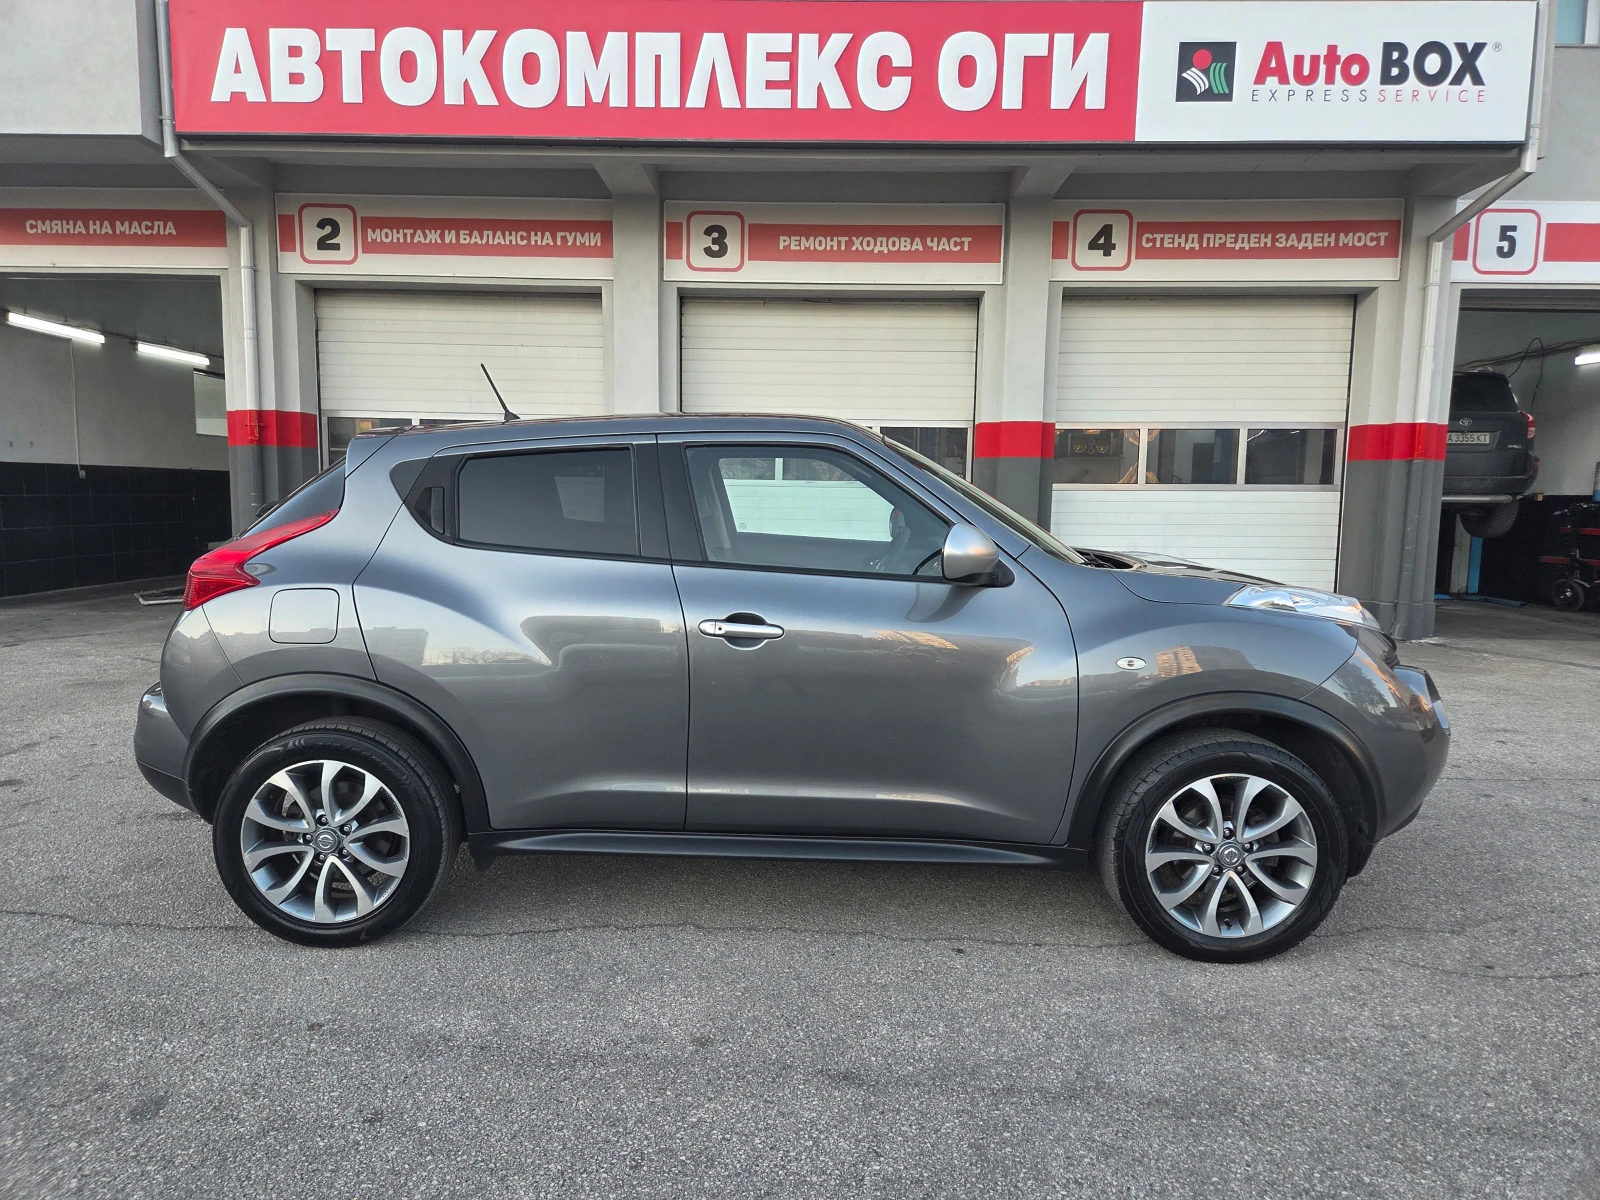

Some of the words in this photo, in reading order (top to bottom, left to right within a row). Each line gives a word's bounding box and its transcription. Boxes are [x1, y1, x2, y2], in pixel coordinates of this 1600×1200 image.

[209, 26, 913, 112] АВТОКОМПЛЕКС
[937, 30, 1110, 112] ОГИ
[1253, 41, 1371, 87] Auto
[1379, 40, 1488, 87] BOX
[25, 219, 87, 235] СМЯНА
[89, 220, 113, 235] НА
[115, 220, 177, 236] МАСЛА
[315, 217, 341, 251] 2
[366, 228, 442, 244] МОНТАЖ
[444, 230, 456, 244] И
[459, 230, 528, 246] БАЛАНС
[530, 231, 554, 246] НА
[556, 232, 602, 247] ГУМИ
[702, 224, 729, 259] 3
[1087, 223, 1117, 257] 4
[1141, 233, 1200, 250] СТЕНД
[1202, 233, 1272, 250] ПРЕДЕН
[1274, 233, 1336, 250] ЗАДЕН
[1338, 232, 1389, 248] МОСТ
[1496, 225, 1518, 259] 5
[779, 236, 849, 251] РЕМОНТ
[851, 236, 924, 254] ХОДОВА
[926, 237, 973, 252] ЧАСТ
[1454, 433, 1476, 443] 3355
